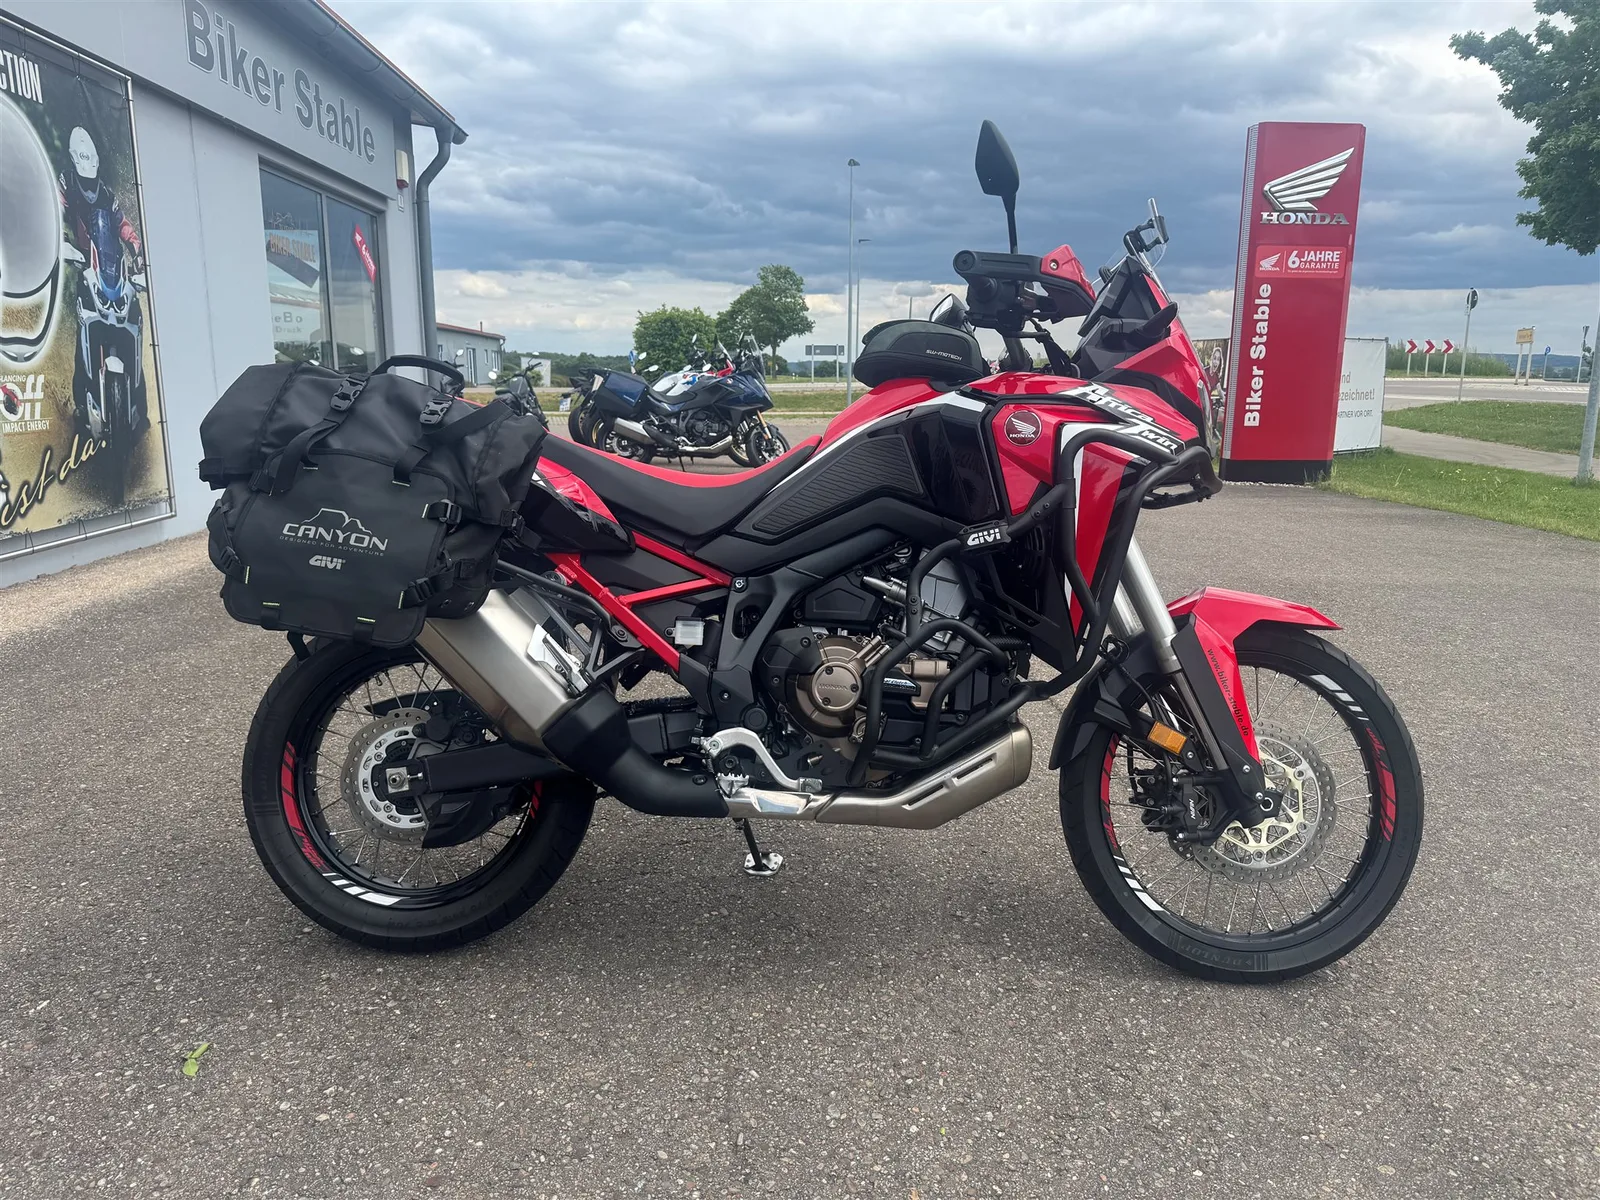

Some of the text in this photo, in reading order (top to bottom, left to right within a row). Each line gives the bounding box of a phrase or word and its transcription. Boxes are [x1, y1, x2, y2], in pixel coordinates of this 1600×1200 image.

[183, 0, 375, 164] Biker Stable
[1260, 212, 1350, 225] HONDA
[1287, 250, 1341, 269] 6 JAHRE
[1244, 283, 1272, 427] Biker Stable
[2, 419, 50, 433] IMPACT ENERGY
[1058, 382, 1180, 452] Africa Twin
[279, 535, 317, 546] DESIGNED
[338, 545, 384, 557] ADVENTURE
[282, 523, 388, 551] CANYON
[967, 528, 1001, 546] GIVI
[309, 554, 342, 570] GIVI
[1207, 648, 1249, 736] www.biker-stable.de
